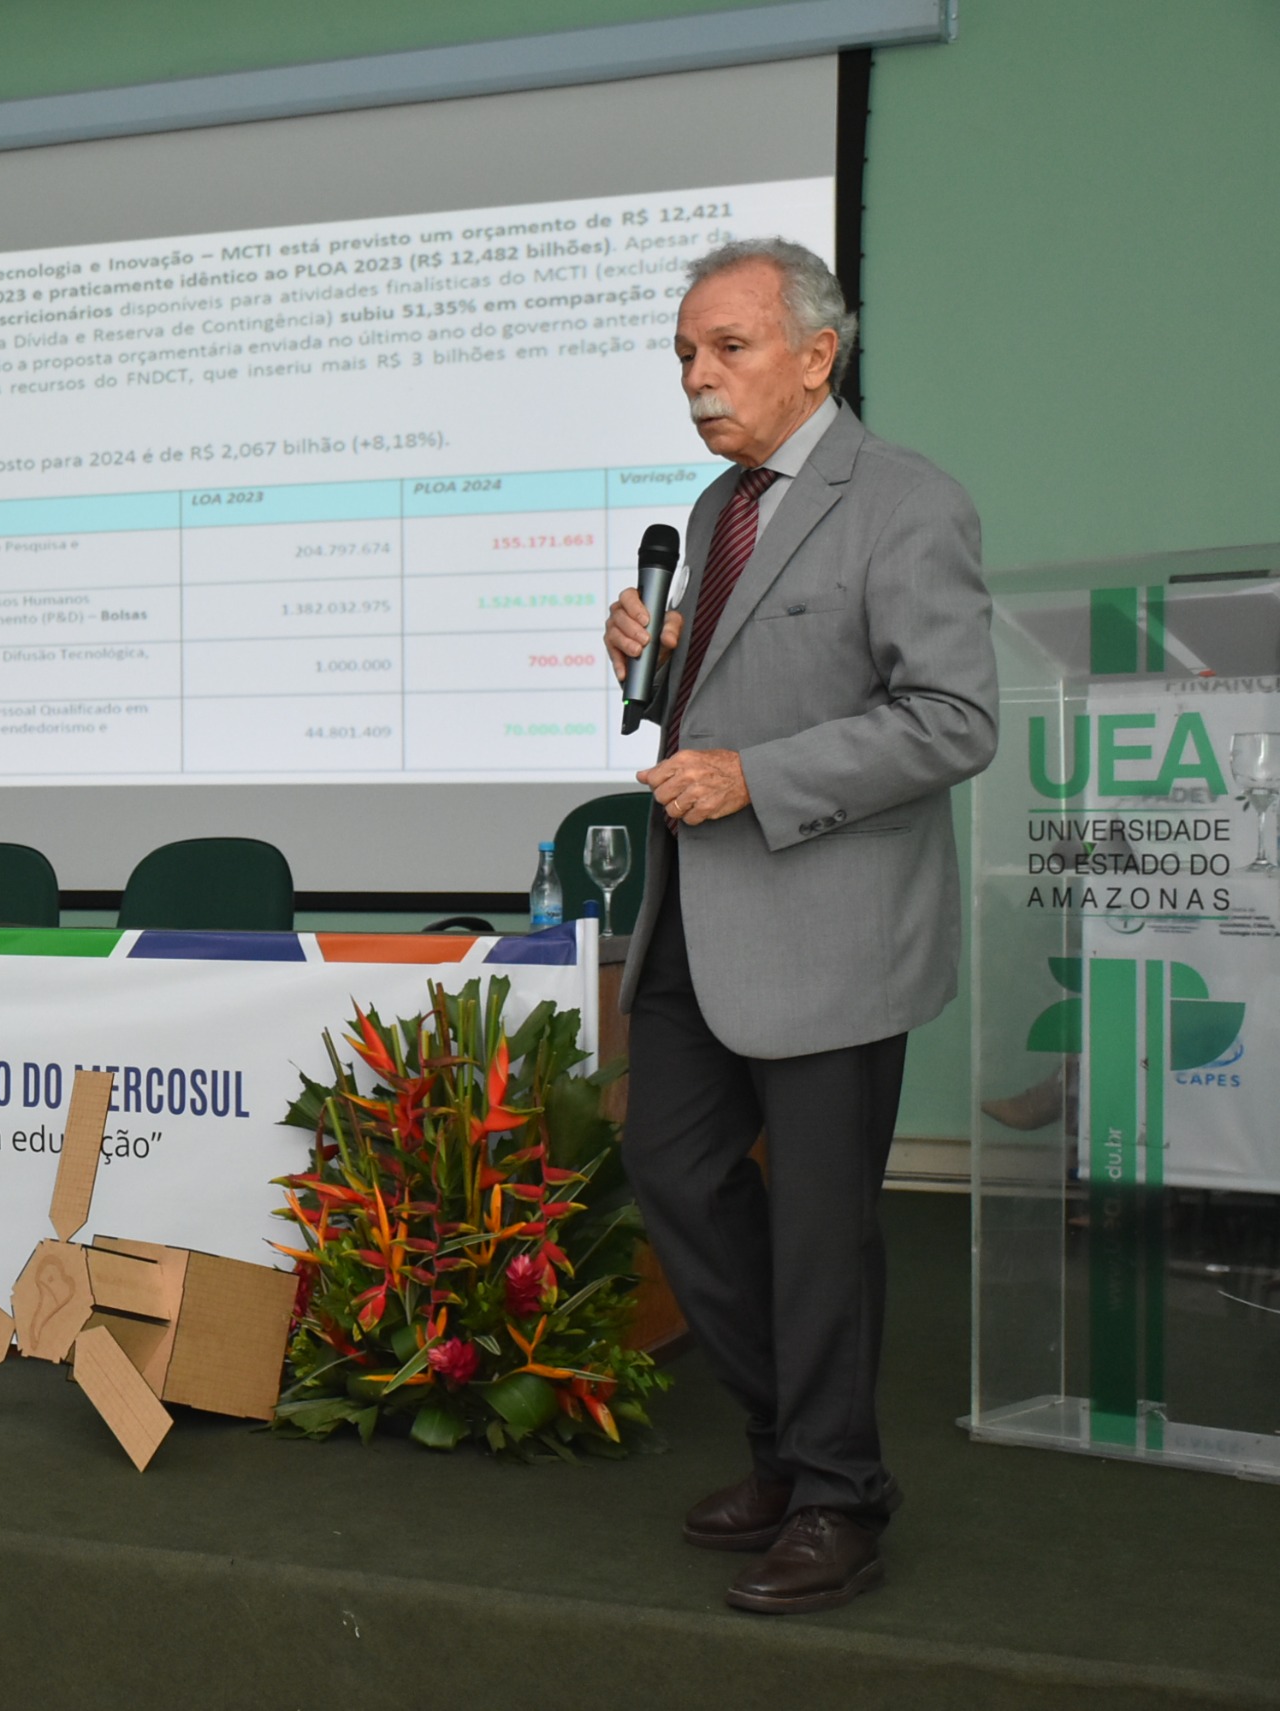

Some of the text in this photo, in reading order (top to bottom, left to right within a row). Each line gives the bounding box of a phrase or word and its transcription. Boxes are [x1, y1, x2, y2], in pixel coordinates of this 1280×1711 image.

[89, 261, 102, 273] e
[108, 250, 195, 272] Inovação
[220, 242, 273, 262] MCTI
[278, 238, 322, 257] está
[328, 232, 413, 257] previsto
[419, 230, 455, 244] um
[461, 218, 579, 243] orçamento
[584, 214, 614, 230] de
[621, 207, 650, 228] R$
[661, 203, 732, 223] 12,421
[31, 288, 44, 301] e
[48, 275, 176, 304] praticamente
[179, 268, 260, 288] idêntico
[264, 267, 290, 281] ao
[294, 259, 349, 278] PLOA
[353, 254, 404, 273] 2023
[409, 249, 444, 273] (R$
[450, 244, 521, 267] 12,482
[525, 237, 617, 259] bilhões).
[624, 234, 700, 255] Apesar
[119, 291, 224, 319] disponíveis
[229, 293, 273, 312] para
[279, 282, 380, 304] atividades
[385, 271, 492, 295] finalísticas
[498, 270, 527, 286] do
[533, 264, 588, 283] MCTI
[13, 327, 70, 348] Dívida
[74, 331, 87, 343] e
[92, 325, 166, 342] Reserva
[170, 319, 196, 336] de
[201, 307, 334, 333] Contingência)
[339, 304, 396, 323] subiu
[401, 297, 478, 319] 51,35%
[482, 298, 519, 312] em
[523, 284, 658, 310] comparação
[40, 456, 85, 475] para
[88, 449, 137, 467] 2024
[141, 448, 155, 464] é
[158, 446, 186, 463] de
[189, 442, 216, 462] R$
[221, 440, 278, 462] 2,067
[282, 436, 348, 456] bilhão
[351, 430, 450, 455] (+8,18%).
[412, 476, 503, 494] PLOA 2024
[619, 467, 698, 486] Variação
[191, 488, 265, 505] LOA 2023
[528, 651, 597, 667] 700.000
[1028, 711, 1229, 800] UEA
[1028, 819, 1231, 842] UNIVERSIDADE
[1028, 853, 1231, 876] DO ESTADO DO
[1026, 886, 1231, 911] AMAZONAS
[22, 1061, 63, 1110] DO
[75, 1064, 250, 1118] ERCOSUL
[1175, 1072, 1242, 1089] CAPES
[11, 1126, 163, 1164] edução”
